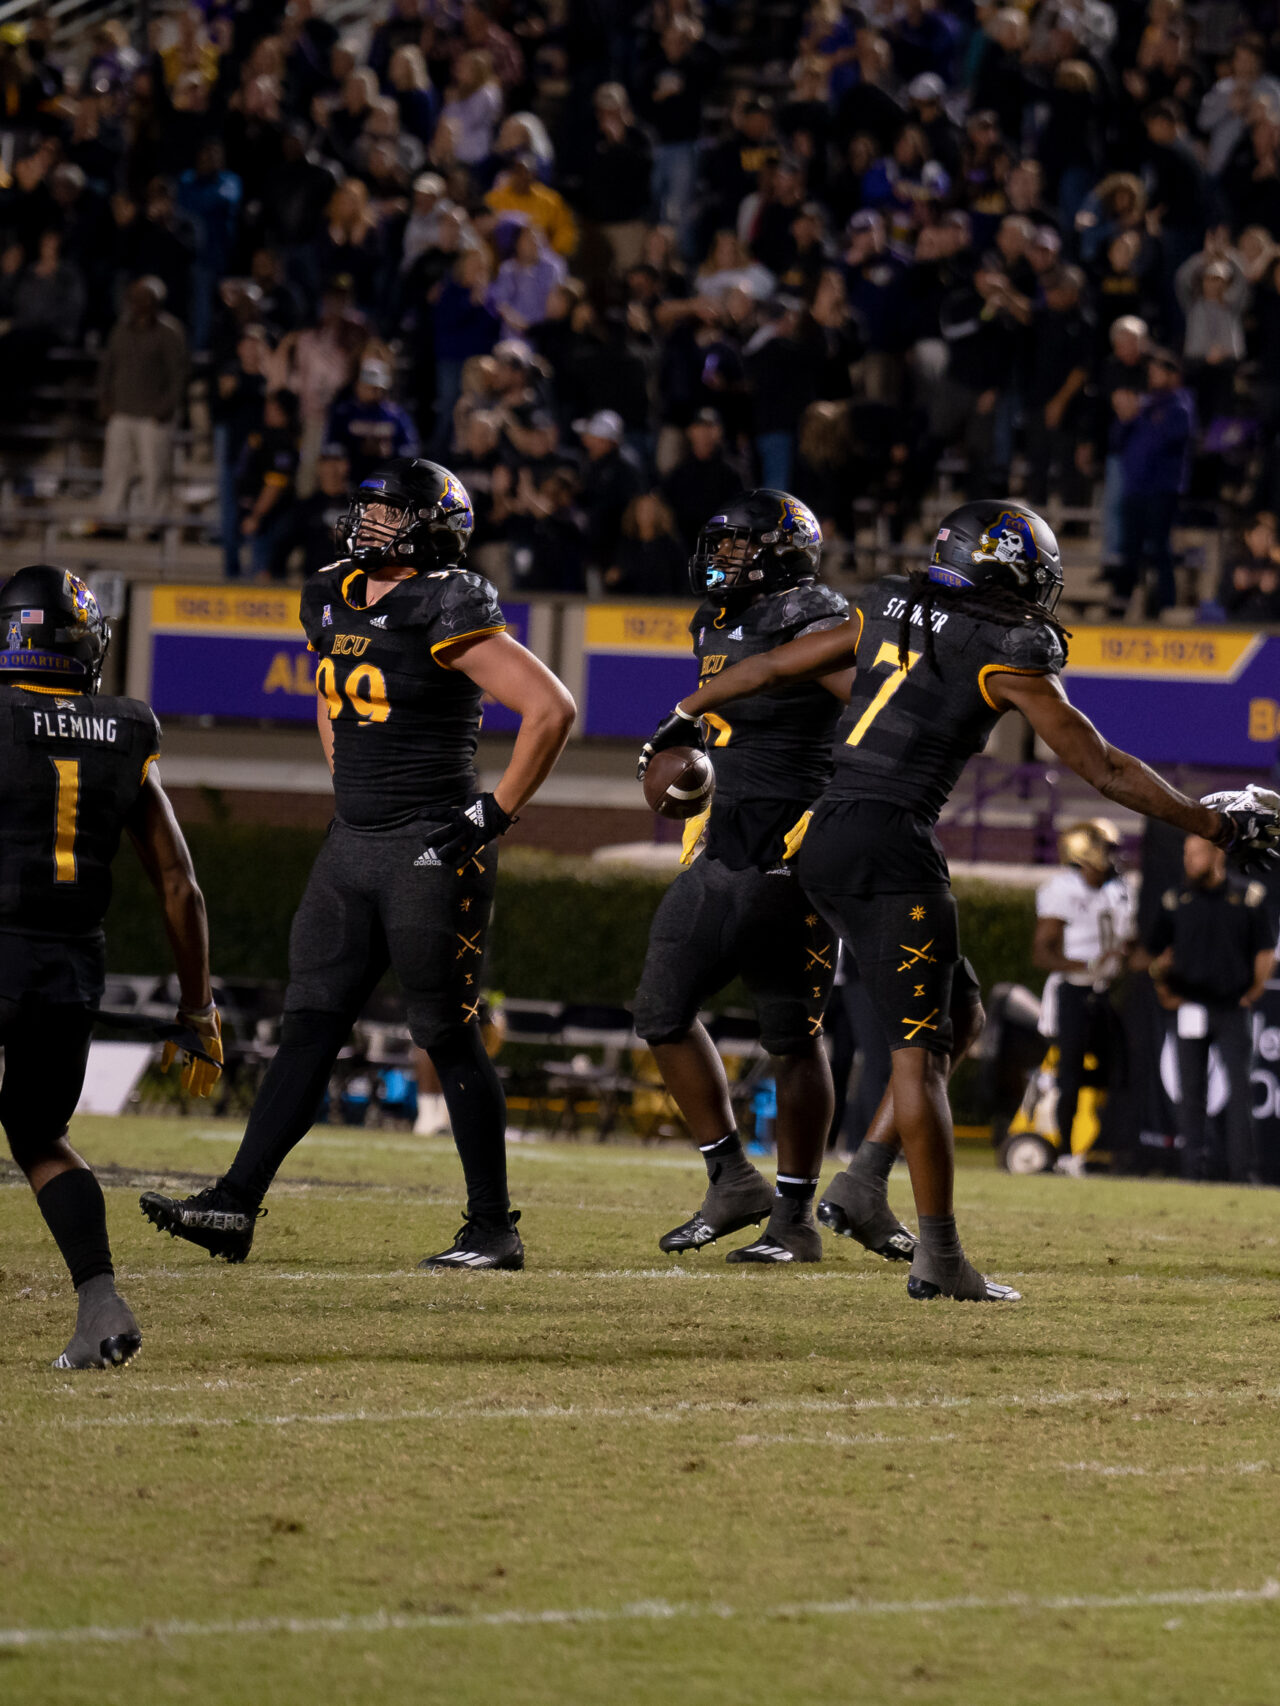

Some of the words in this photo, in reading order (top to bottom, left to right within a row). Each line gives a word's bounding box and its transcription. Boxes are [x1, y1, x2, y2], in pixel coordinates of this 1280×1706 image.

[1005, 517, 1024, 531] ECU
[331, 634, 372, 657] ECU
[11, 655, 71, 670] QUARTER
[315, 656, 392, 727] 99
[844, 638, 924, 748] 7
[33, 711, 118, 743] FLEMING
[49, 757, 80, 885] 1
[475, 800, 485, 828] adidas
